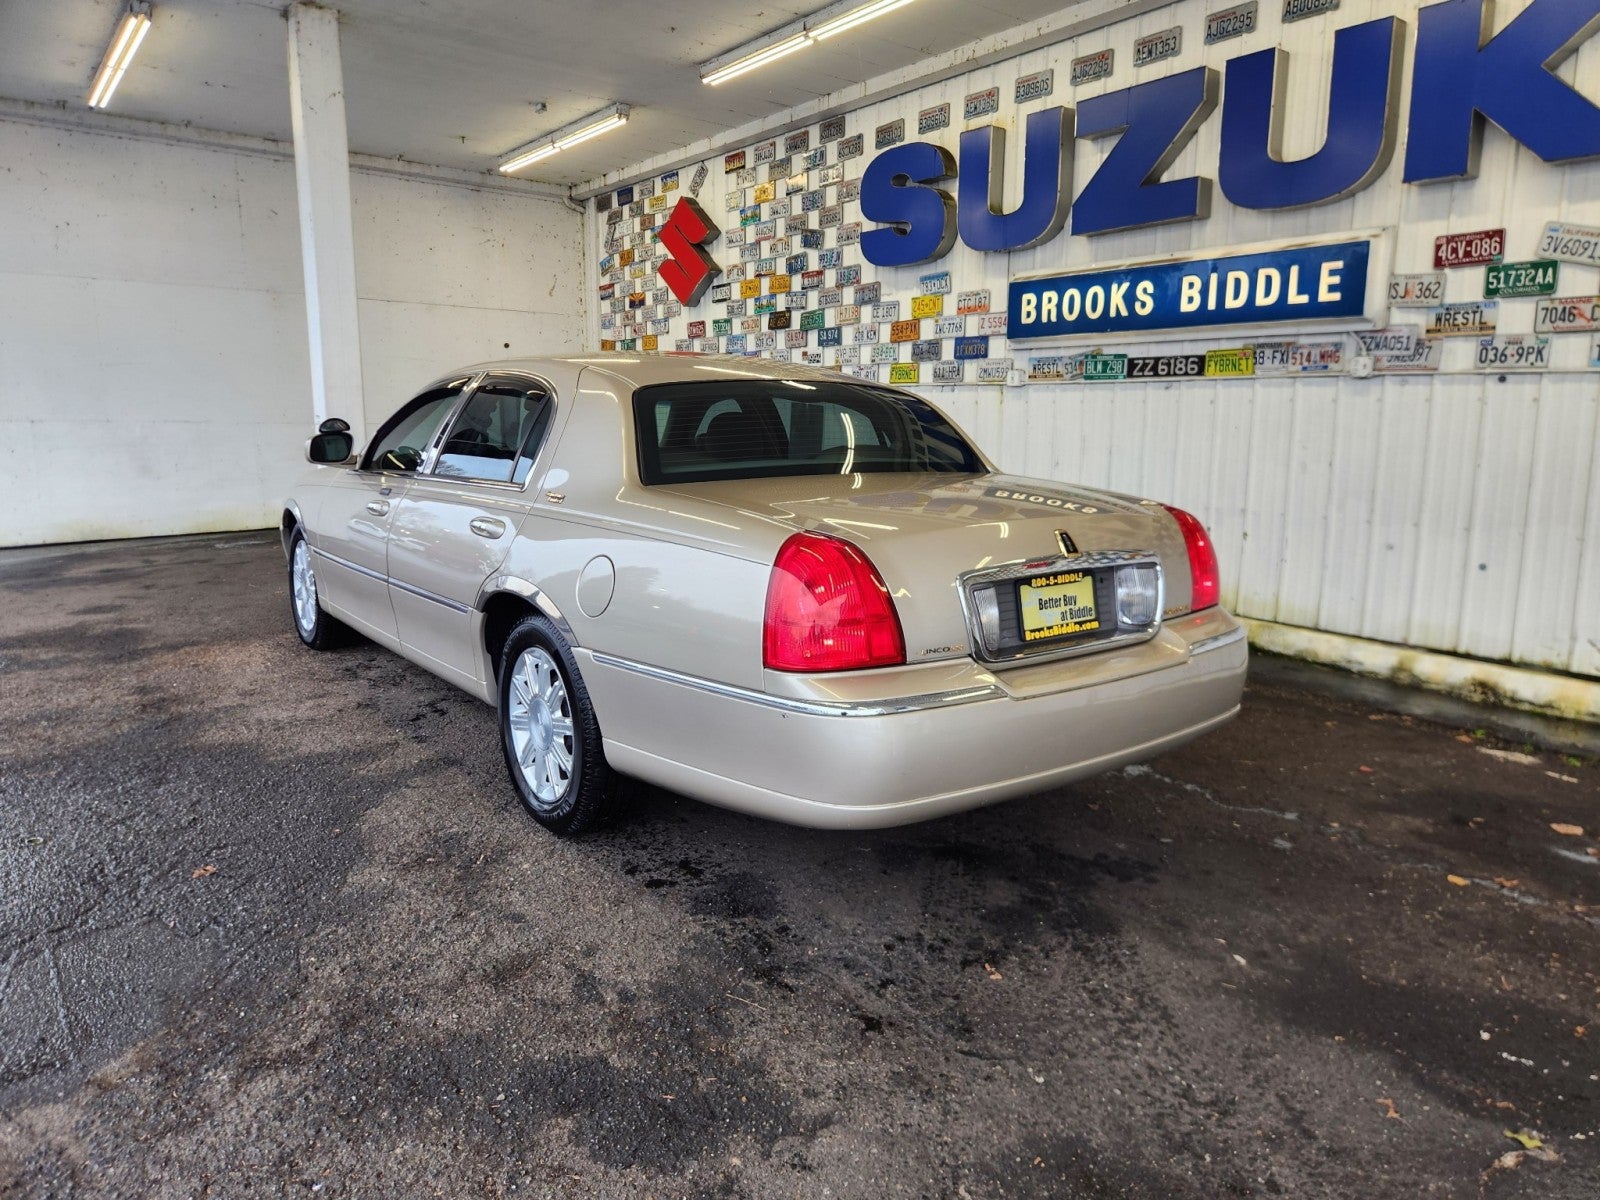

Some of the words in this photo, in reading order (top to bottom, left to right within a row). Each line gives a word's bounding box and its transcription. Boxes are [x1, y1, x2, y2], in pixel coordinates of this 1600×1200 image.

[1207, 16, 1253, 41] AJG2295
[1437, 236, 1501, 261] 4CV-086
[1541, 235, 1600, 263] 3V6091
[1488, 267, 1554, 290] 51732AA
[1020, 280, 1155, 325] BROOKS
[1180, 260, 1345, 313] BIDDLE
[1414, 281, 1441, 299] 362
[1434, 310, 1487, 327] WRESTL
[1541, 305, 1577, 325] 7046
[1106, 360, 1123, 374] 298
[1132, 358, 1154, 376] ZZ
[1157, 357, 1199, 375] 6186
[1038, 596, 1062, 611] Better
[1063, 593, 1077, 607] Buy
[1060, 611, 1069, 622] at
[1069, 605, 1094, 621] Biddle
[1025, 620, 1100, 641] BrooksBiddle.com
